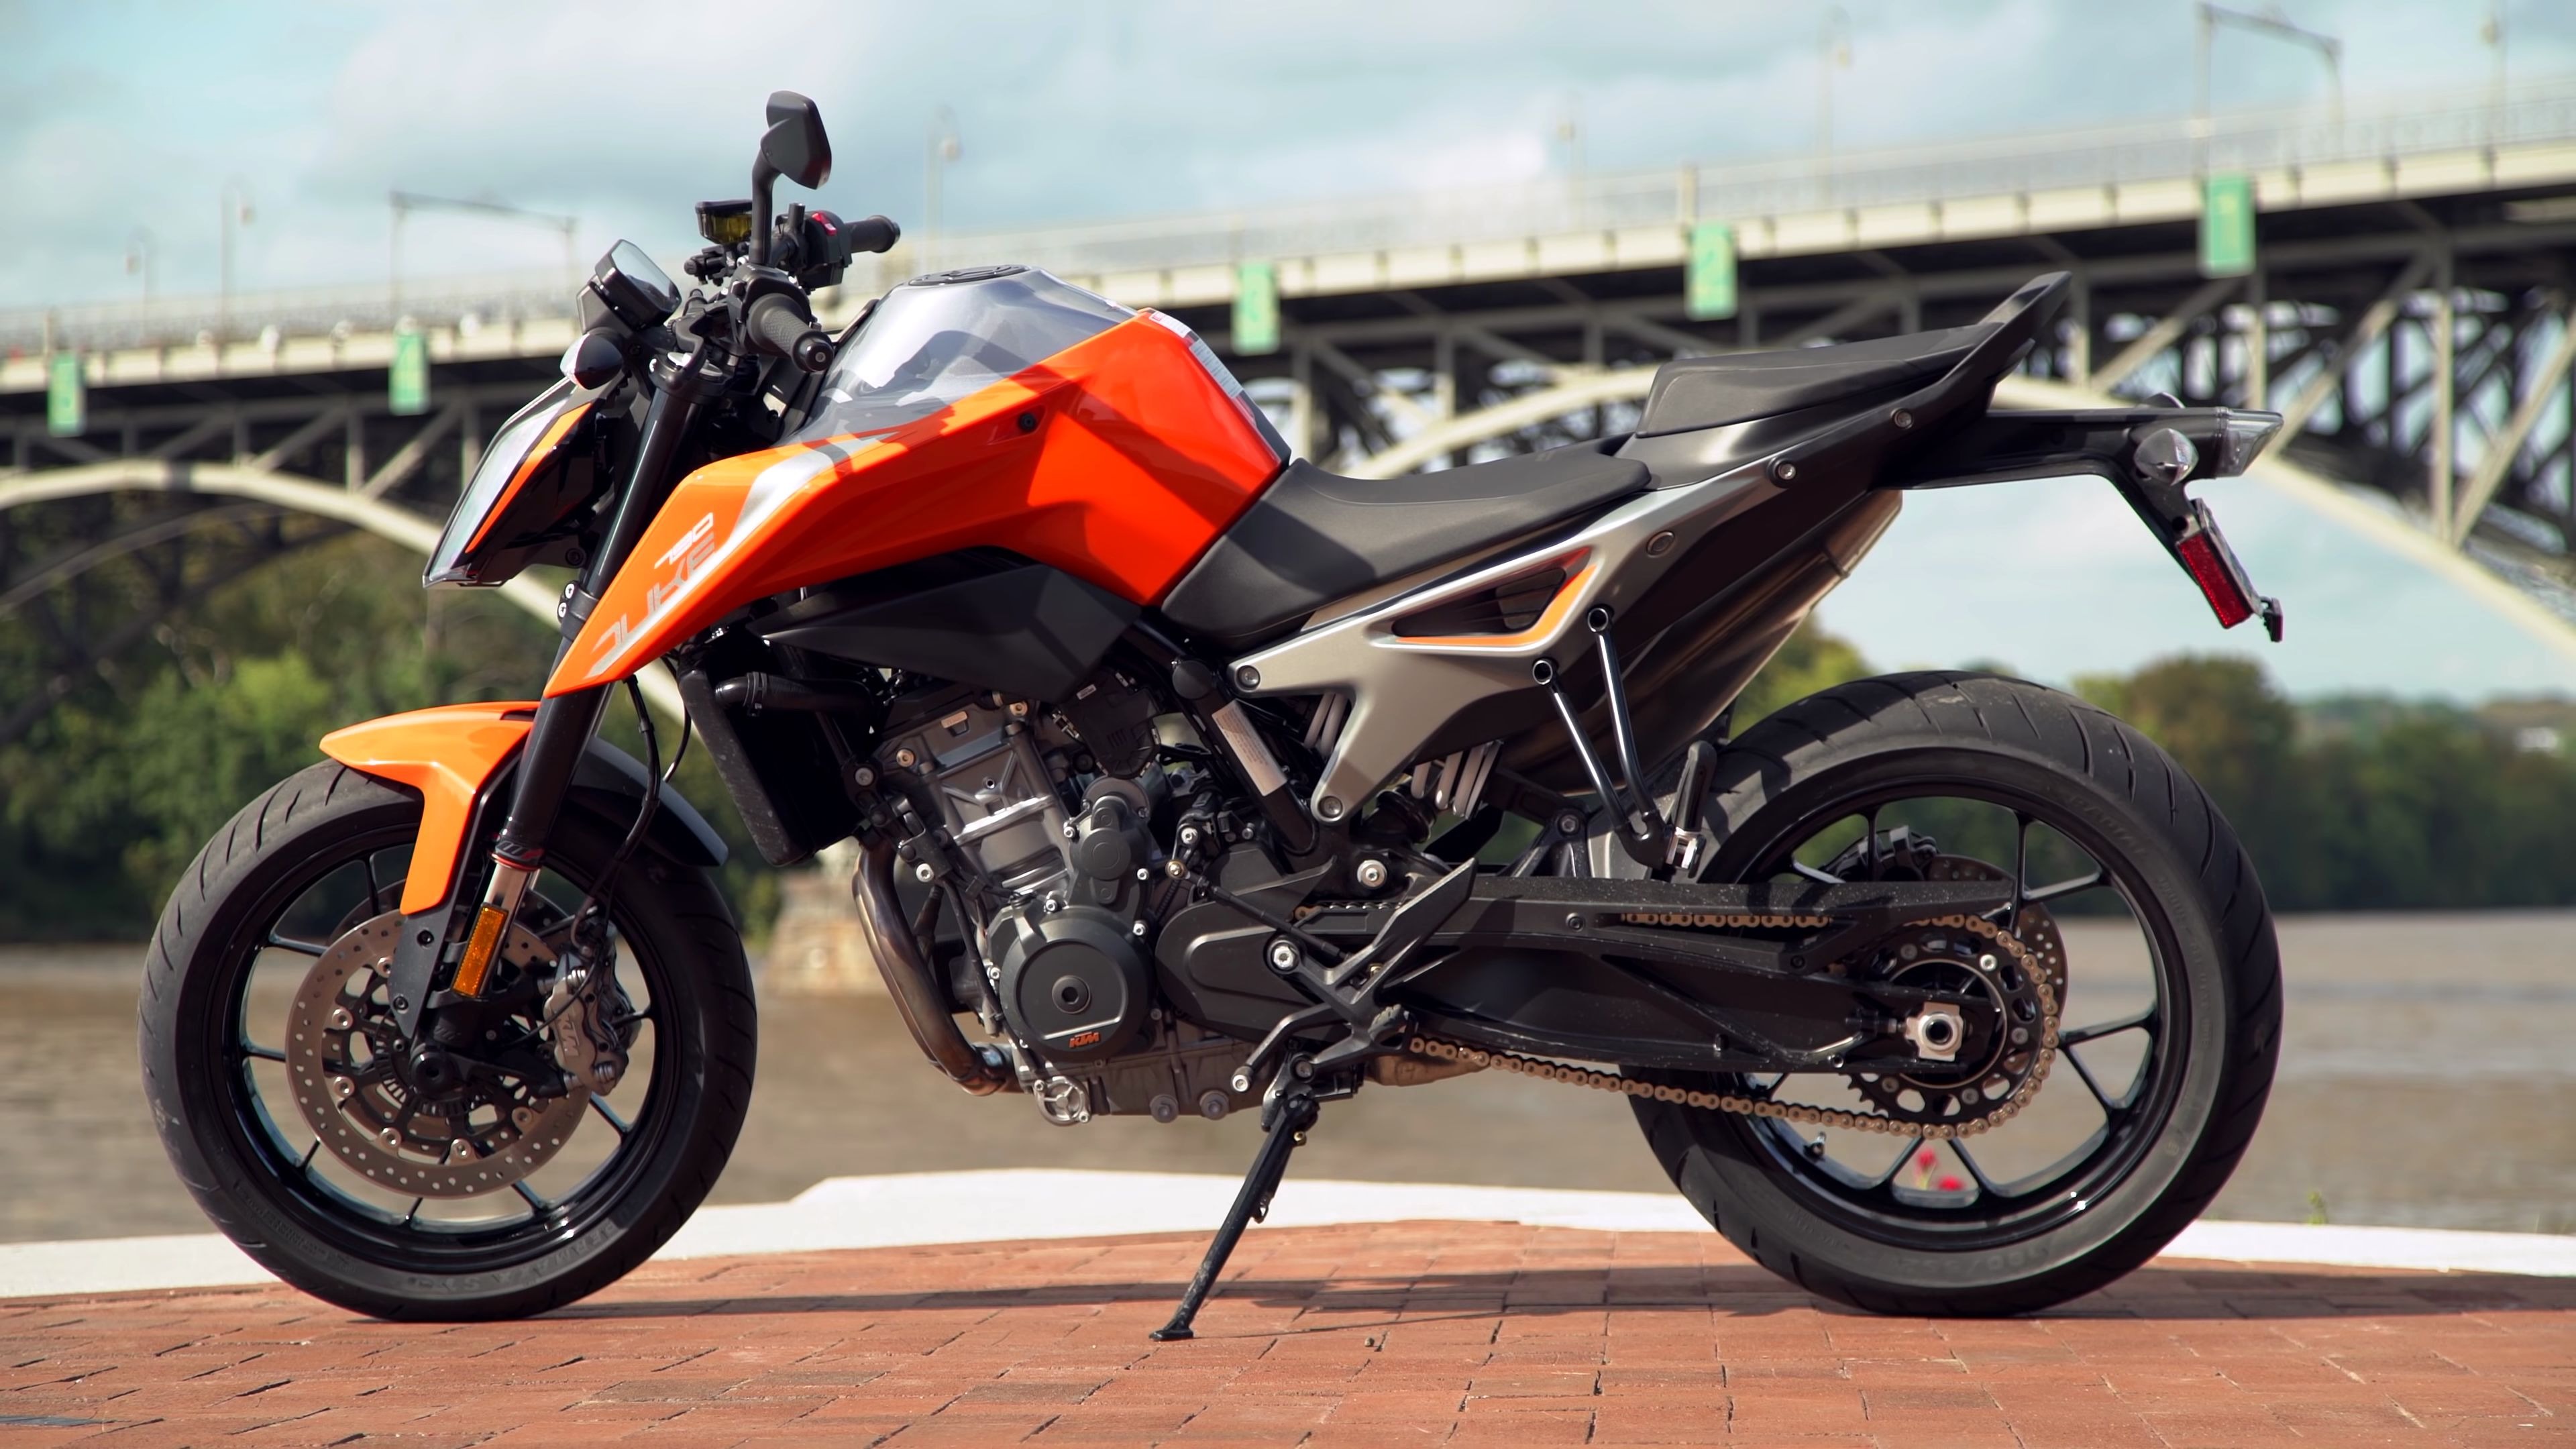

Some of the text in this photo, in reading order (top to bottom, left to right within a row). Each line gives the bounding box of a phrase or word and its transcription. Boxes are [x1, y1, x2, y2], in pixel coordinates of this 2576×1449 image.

[1692, 235, 1733, 301] 2
[653, 511, 714, 570] 790
[582, 531, 715, 680] DUKE
[1069, 1032, 1099, 1048] KTM
